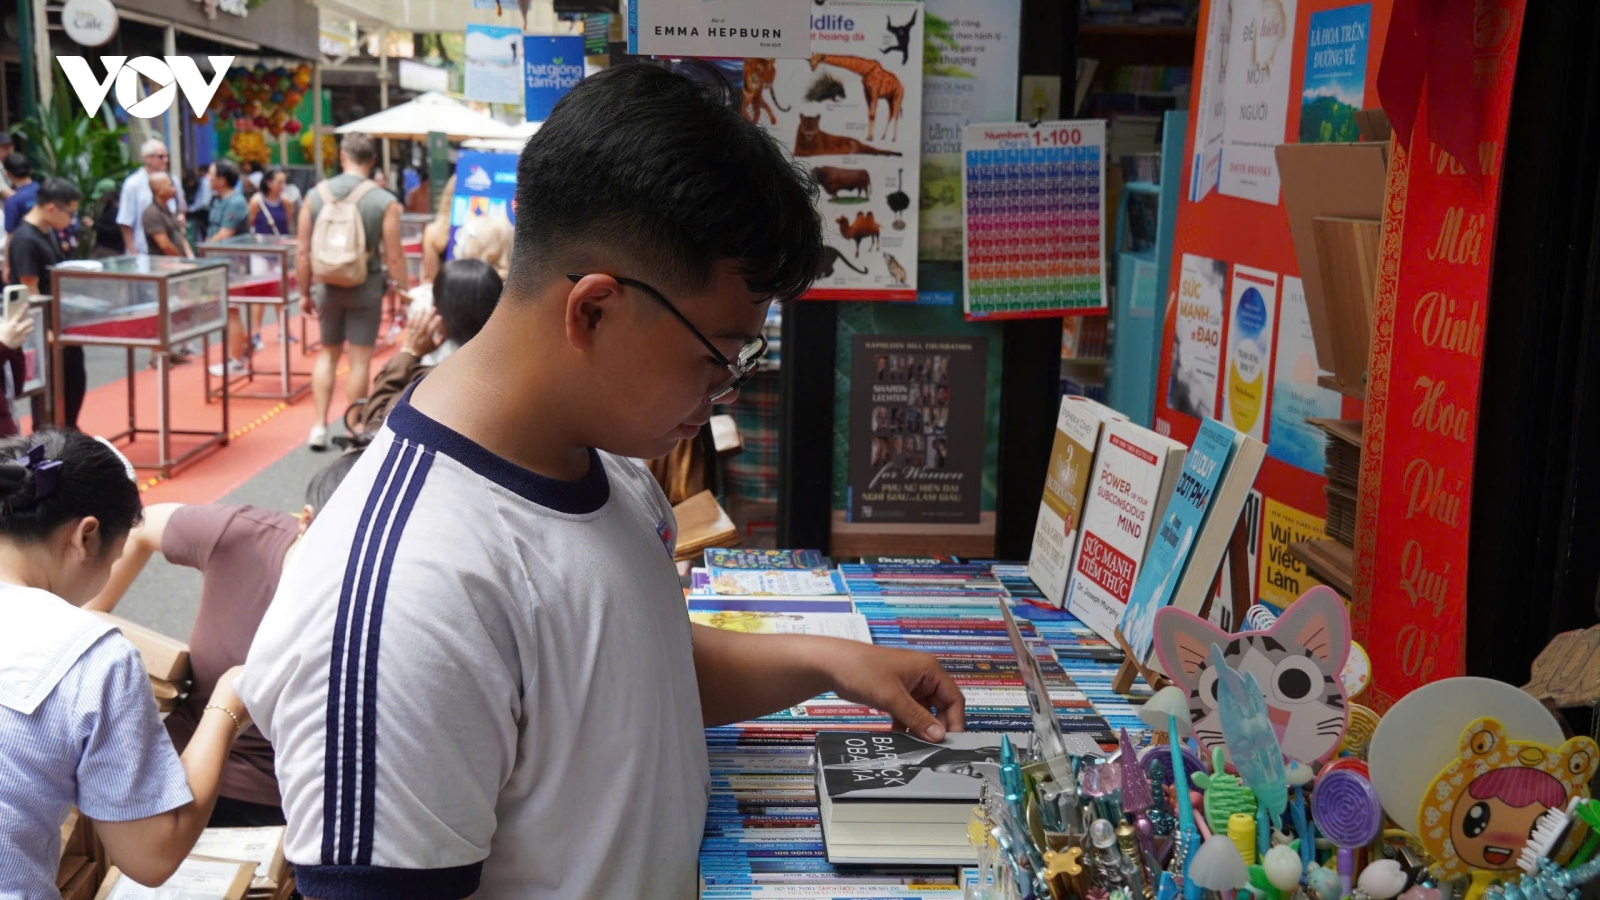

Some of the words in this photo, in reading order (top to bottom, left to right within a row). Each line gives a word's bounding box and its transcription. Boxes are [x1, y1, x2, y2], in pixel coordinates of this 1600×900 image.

[655, 26, 699, 36] EMMA
[708, 27, 781, 38] HEPBURN
[810, 15, 854, 31] ldlife
[1322, 27, 1340, 47] HOA
[1341, 22, 1366, 45] TRÊN
[819, 33, 850, 42] hoang
[984, 131, 1029, 141] Numbers
[1033, 128, 1081, 146] 1-100
[1247, 165, 1271, 177] BROOKS
[1427, 206, 1485, 266] Mới
[1179, 303, 1209, 323] MẠNH
[1412, 291, 1480, 357] Vinh
[865, 342, 904, 350] NAPOLEON
[925, 342, 972, 351] FOUNDATION
[873, 385, 907, 393] SHARON
[873, 394, 907, 402] LECHTER
[1412, 375, 1469, 444] Hoa
[868, 462, 898, 490] for
[902, 465, 963, 481] Women
[1101, 469, 1131, 496] POWER
[1131, 492, 1137, 500] OF
[1137, 495, 1148, 507] YOUR
[1097, 486, 1146, 521] SUBCONSCIOUS
[1117, 514, 1142, 539] MIND
[1270, 522, 1291, 545] Vui
[1084, 536, 1103, 561] SỨC
[1101, 548, 1133, 580] MẠNH
[1102, 566, 1128, 599] THỨC
[1267, 566, 1299, 595] Làm
[1084, 587, 1100, 604] Joseph
[1101, 599, 1119, 620] Murphy
[845, 738, 875, 782] OBAMA
[872, 737, 907, 785] BARACK
